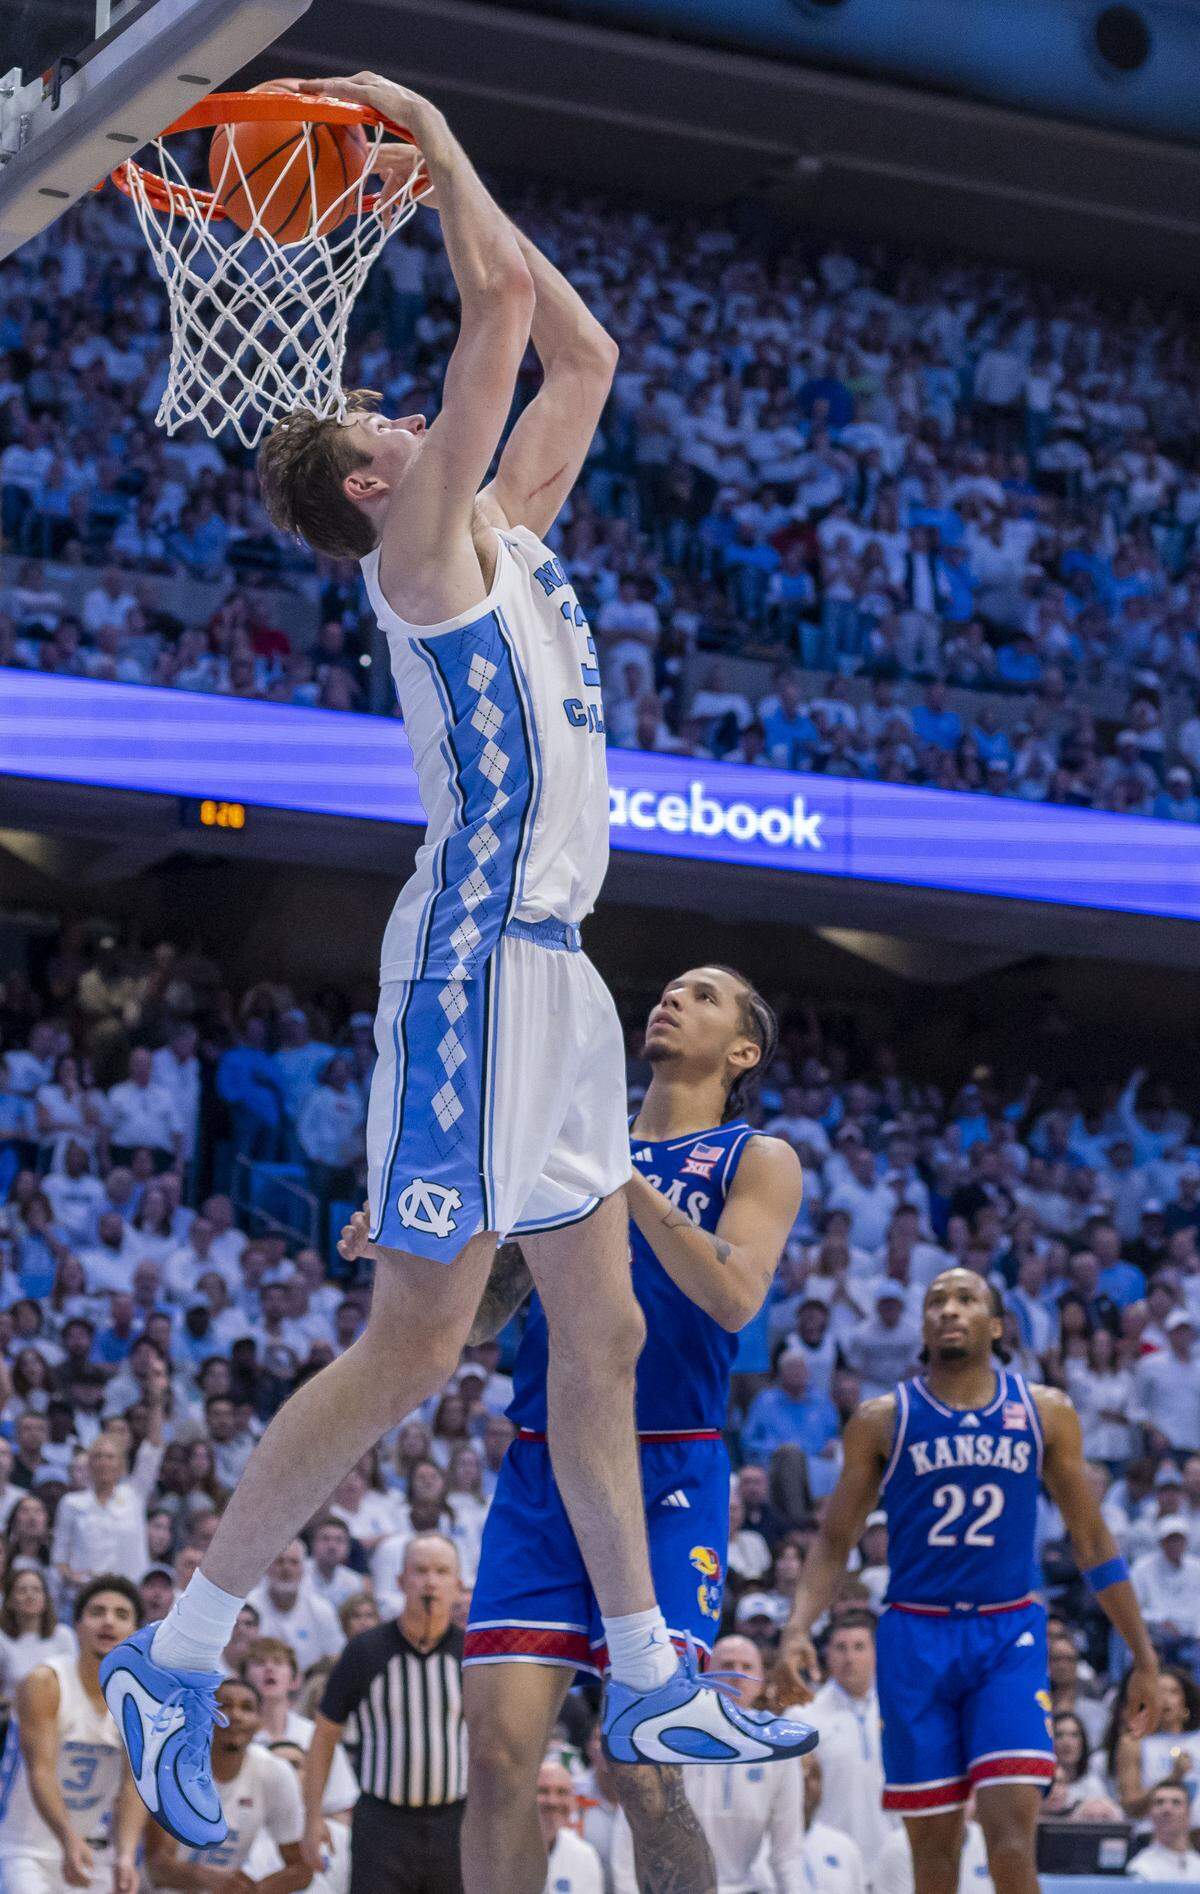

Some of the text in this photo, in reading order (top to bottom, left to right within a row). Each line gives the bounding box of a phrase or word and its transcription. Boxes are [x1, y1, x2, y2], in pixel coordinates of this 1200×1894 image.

[608, 780, 823, 848] acebook
[908, 1434, 1032, 1476] KANSAS
[927, 1484, 1005, 1547] 22
[63, 1756, 99, 1791] 3
